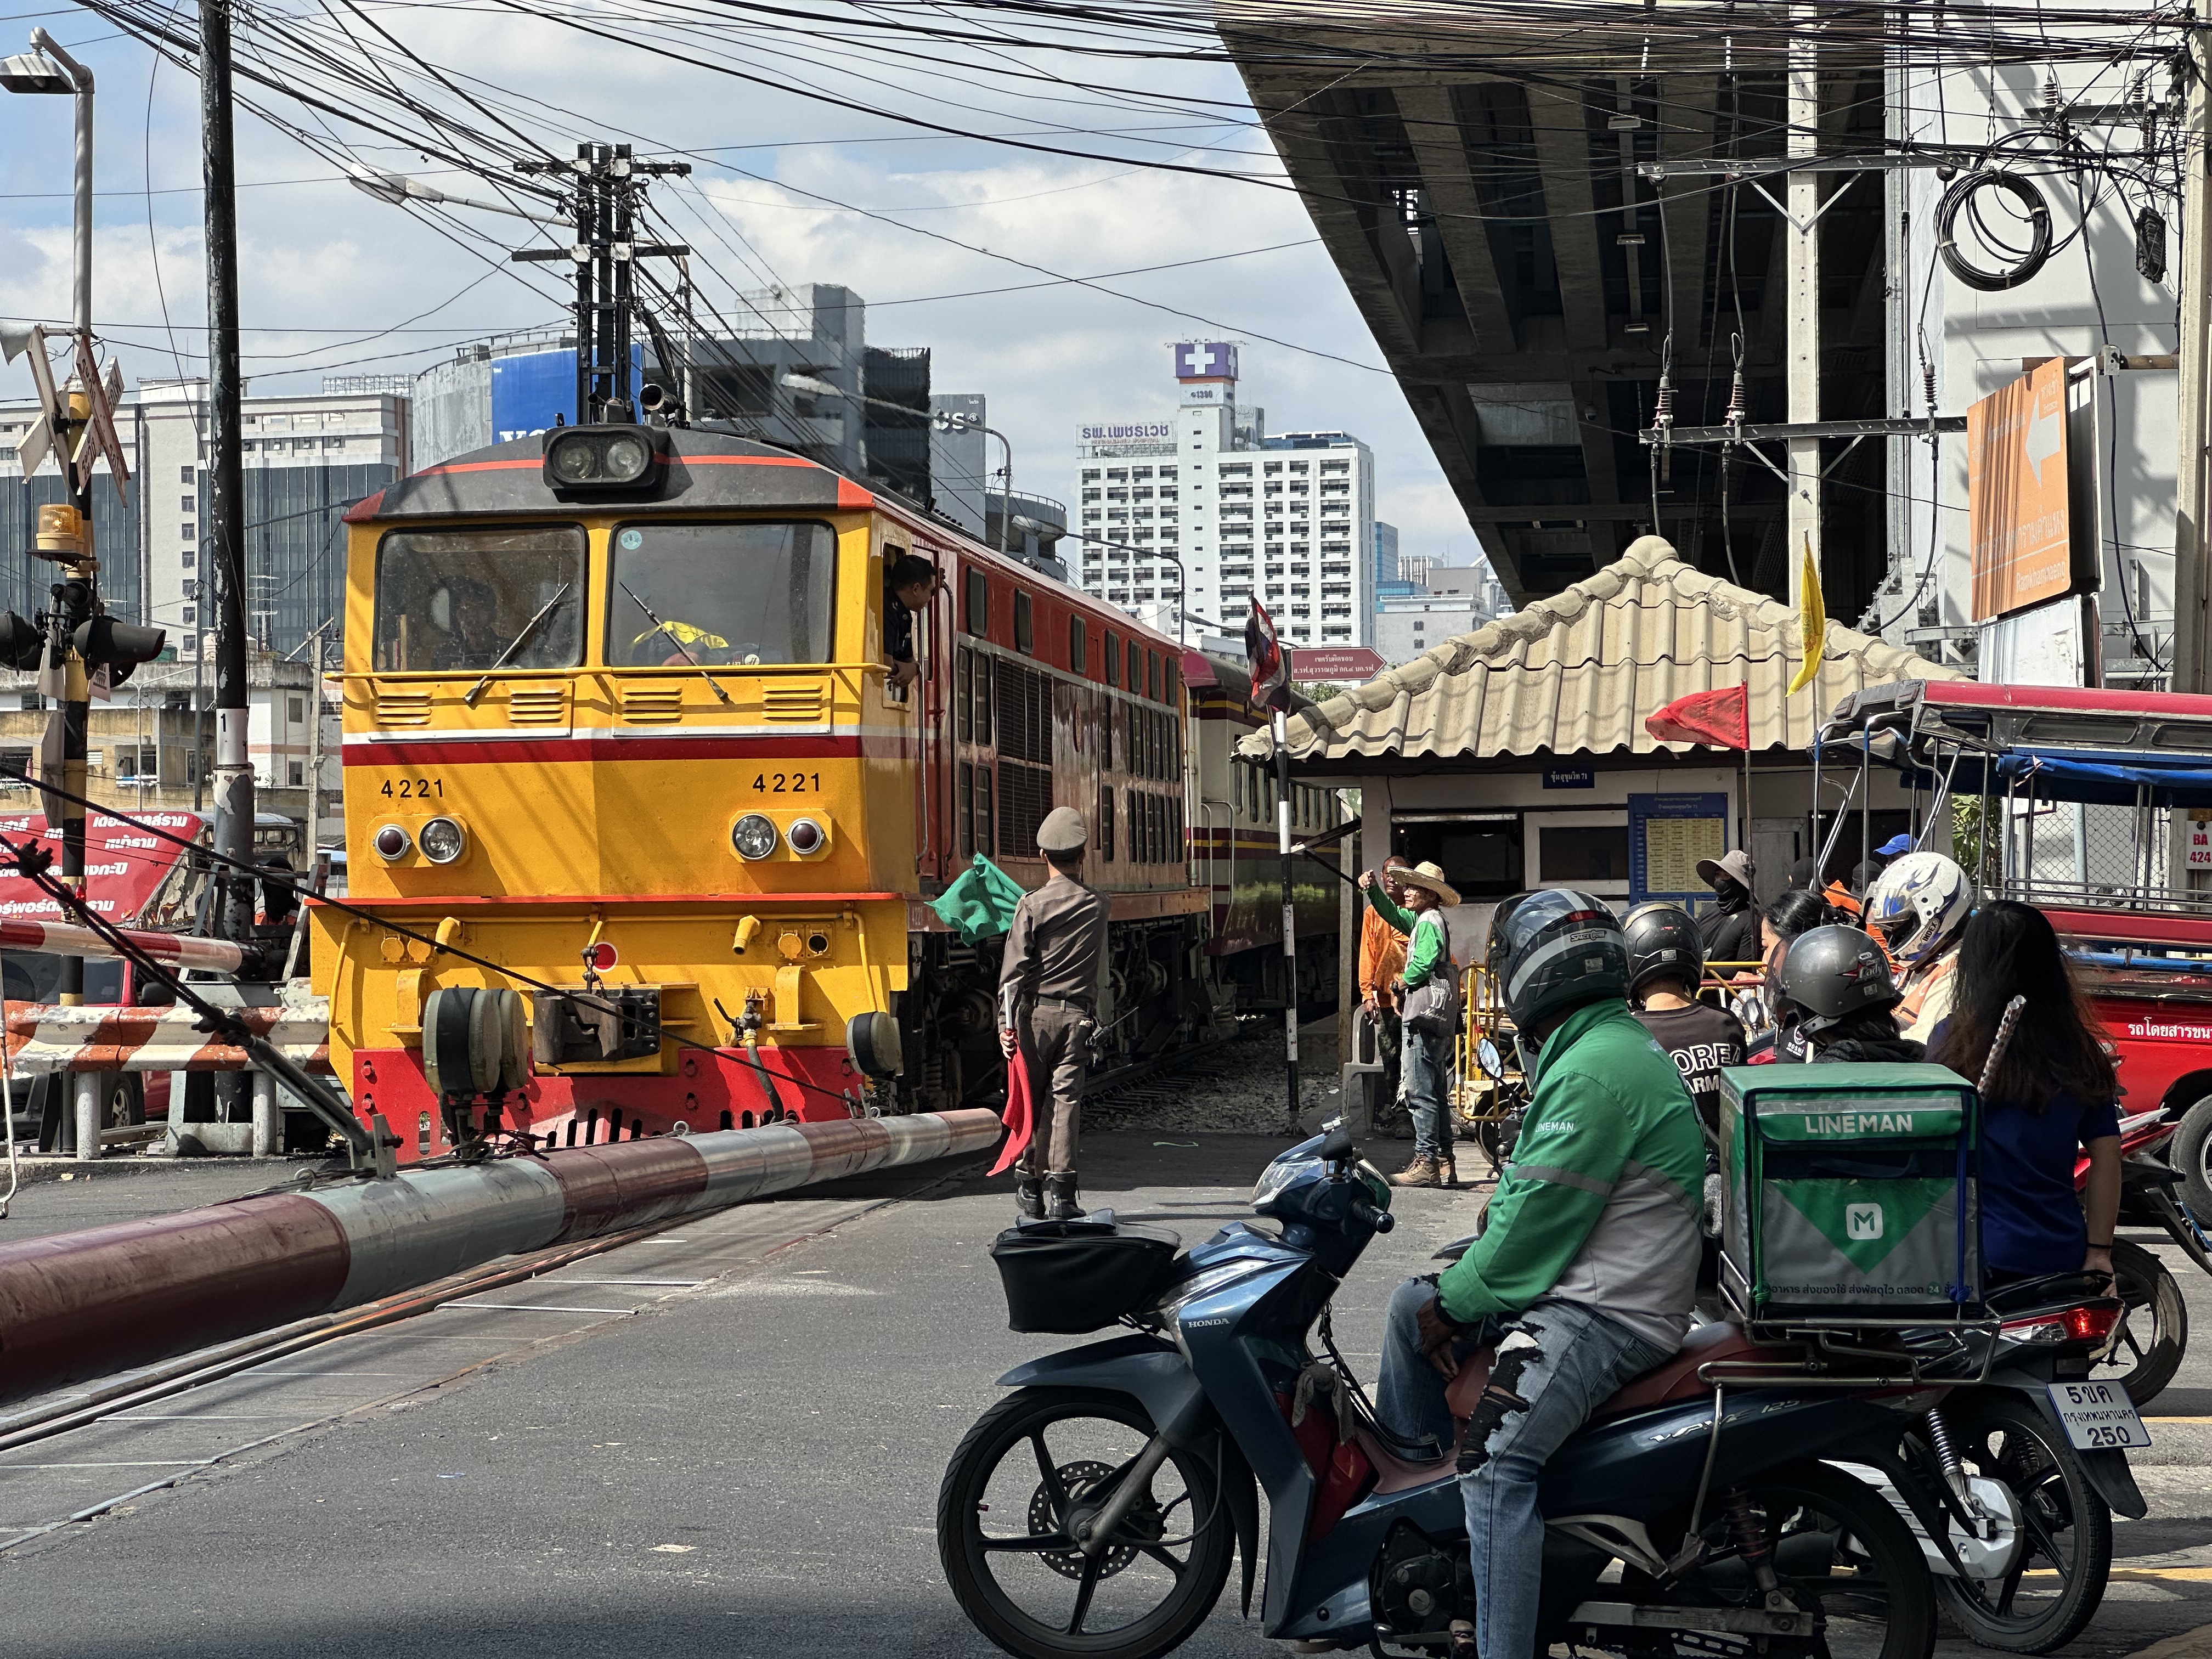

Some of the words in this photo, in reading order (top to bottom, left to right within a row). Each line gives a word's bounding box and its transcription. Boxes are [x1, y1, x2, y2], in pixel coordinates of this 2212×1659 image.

[220, 713, 226, 732] 1
[381, 778, 444, 799] 4221
[752, 772, 821, 793] 4221
[2193, 833, 2208, 845] BA
[2190, 851, 2211, 863] 424
[1922, 921, 1937, 943] INDEX
[2128, 1016, 2212, 1040] รถโดยสารขน
[1897, 1286, 1924, 1295] ตลอด
[1928, 1285, 1940, 1294] 24
[1188, 1318, 1231, 1328] HONDA
[2065, 1385, 2114, 1404] 5ขค
[1761, 1400, 1801, 1414] 125
[2063, 1409, 2136, 1426] กรุงเทพมหานคร
[2087, 1426, 2131, 1447] 250
